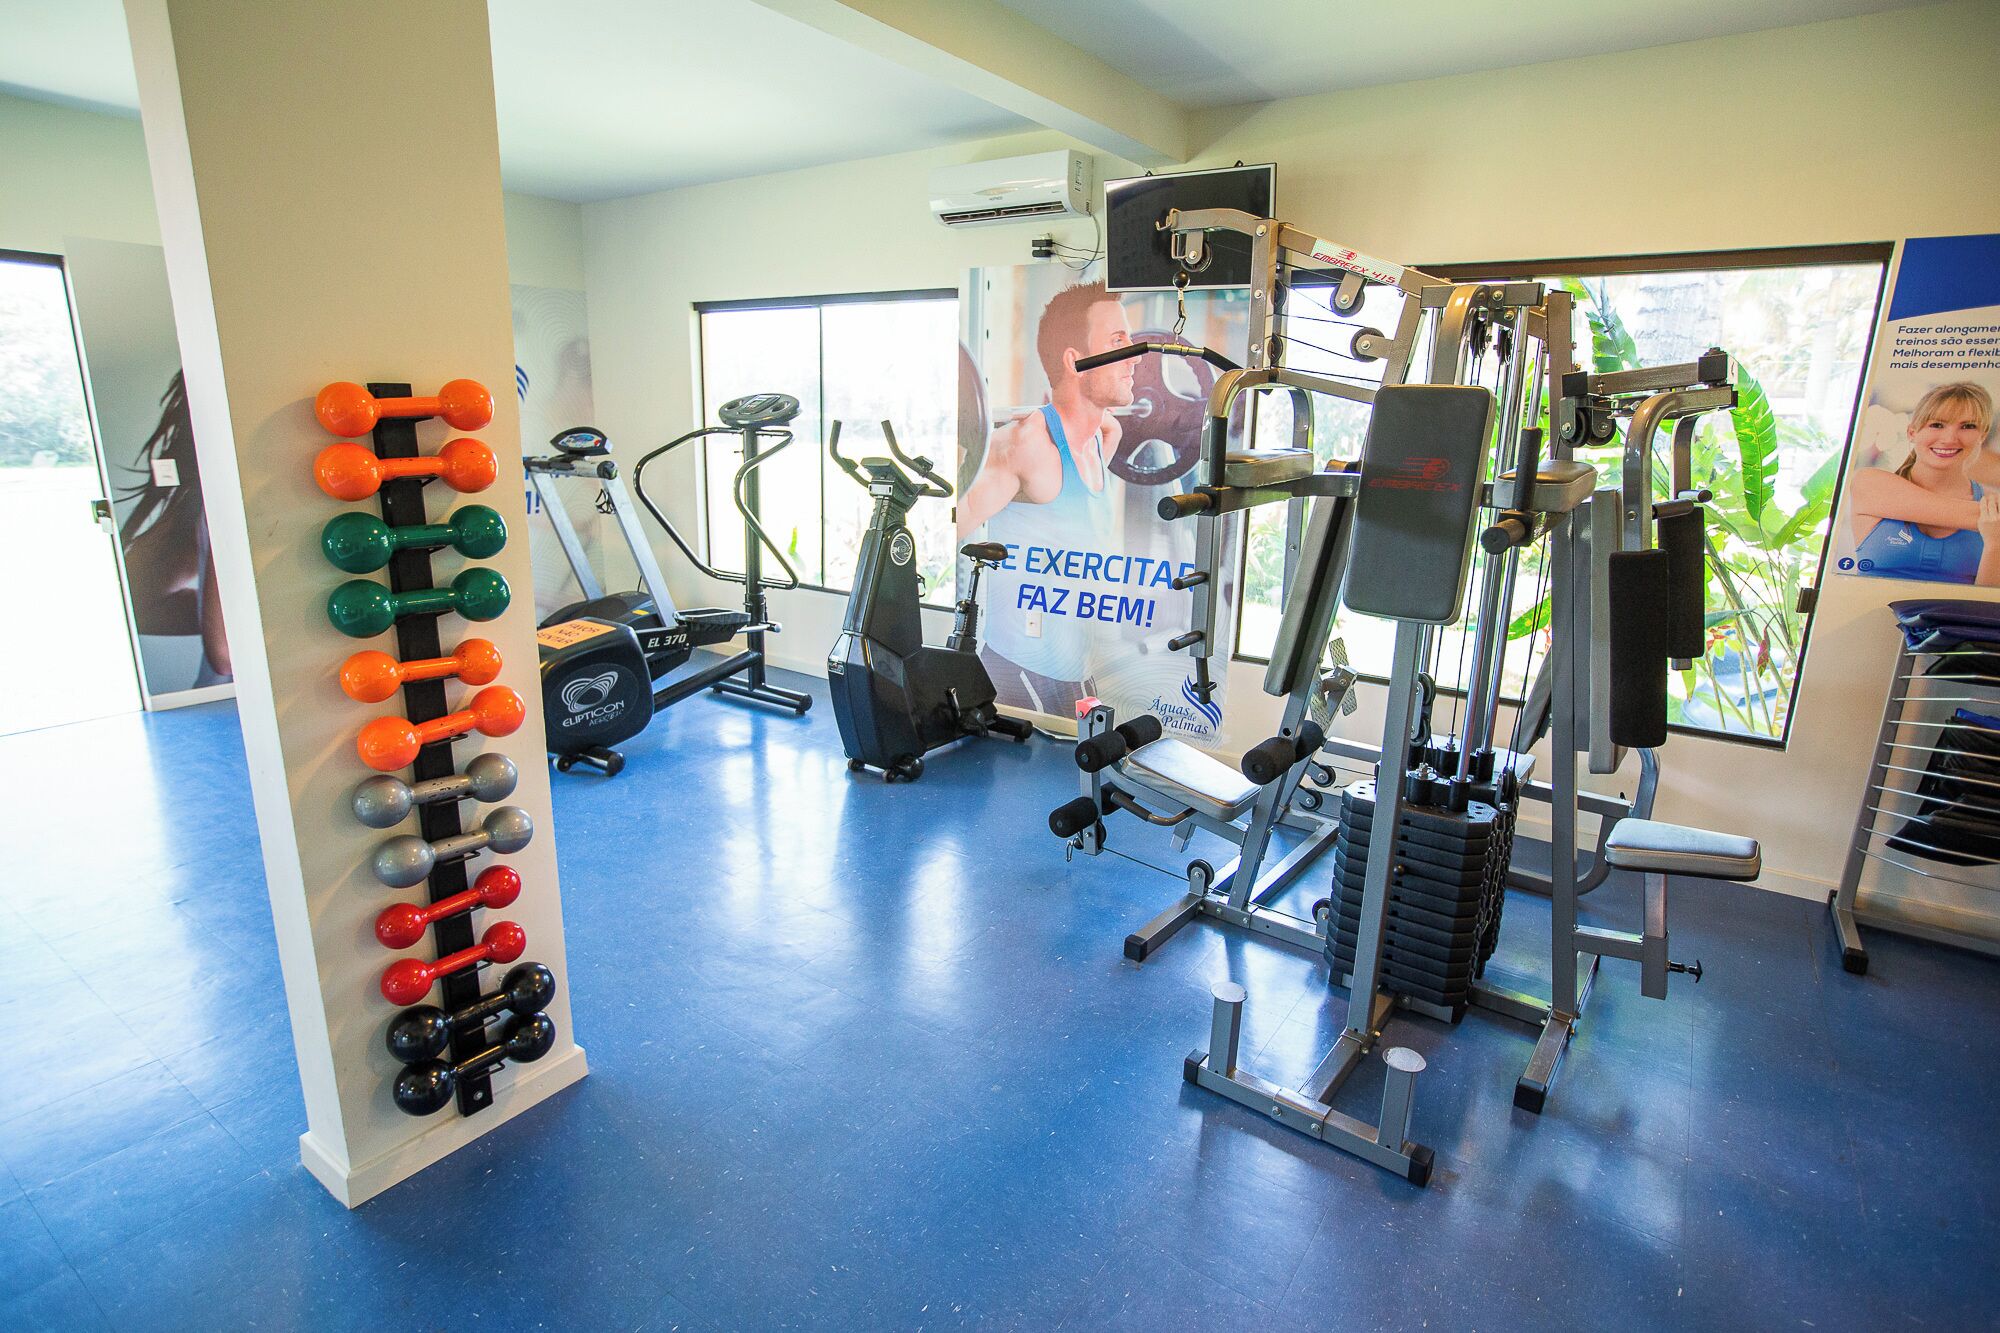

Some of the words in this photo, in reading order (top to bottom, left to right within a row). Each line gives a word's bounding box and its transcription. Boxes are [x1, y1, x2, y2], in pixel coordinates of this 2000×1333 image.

[1312, 252, 1369, 274] EMBREEX
[1898, 325, 1933, 334] Fazer
[1935, 325, 2000, 336] alongame
[1895, 337, 1938, 346] treinos
[1940, 336, 1963, 345] são
[1893, 348, 1954, 357] Melhoram
[1890, 360, 1919, 369] mais
[1001, 543, 1020, 571] E
[1016, 583, 1070, 616] FAZ
[1076, 591, 1156, 628] BEM!
[647, 637, 660, 648] EL
[663, 633, 687, 646] 370
[562, 700, 625, 727] ELIPTICON
[1147, 695, 1190, 716] Águas
[1187, 712, 1197, 722] de
[1161, 715, 1209, 735] Palmas
